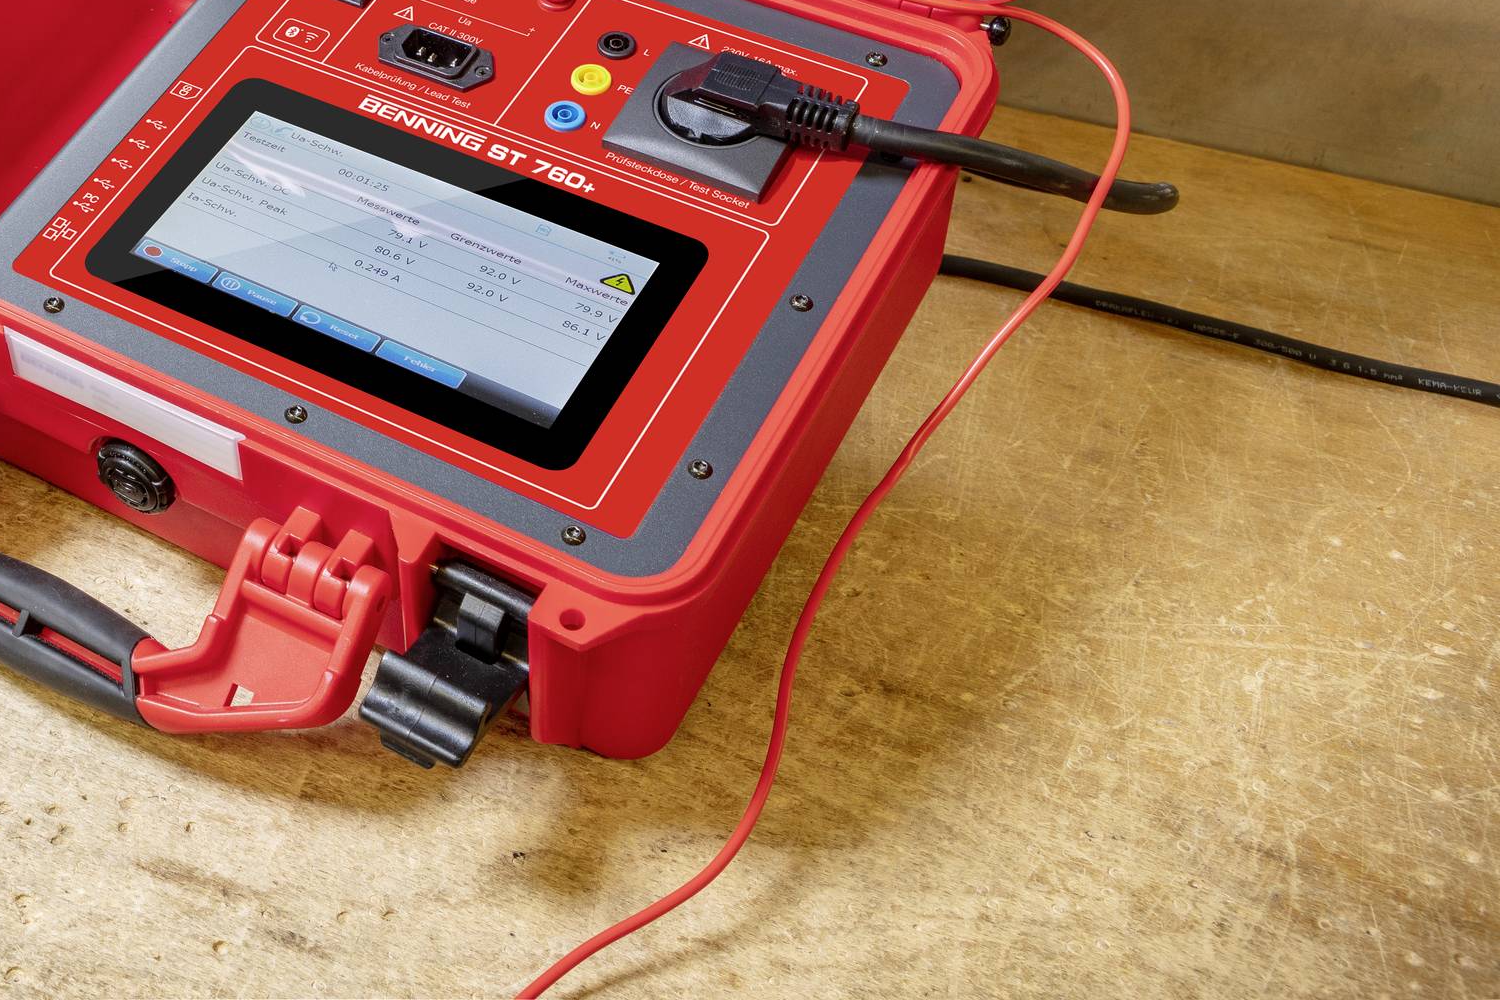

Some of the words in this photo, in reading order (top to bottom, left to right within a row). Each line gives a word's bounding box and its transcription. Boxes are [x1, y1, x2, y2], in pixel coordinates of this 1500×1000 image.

[458, 16, 472, 26] Ua
[428, 22, 448, 33] CAT
[457, 32, 483, 45] 300V
[355, 62, 417, 90] Kabelprüfung
[424, 88, 449, 101] Lead
[451, 96, 471, 109] Test
[617, 85, 634, 96] PE
[590, 121, 601, 130] N
[290, 131, 344, 158] Ua-Schw.
[358, 94, 487, 152] BENNING
[487, 145, 527, 166] ST
[531, 159, 596, 194] 760+
[241, 131, 287, 153] Testzeit
[338, 168, 390, 192] 00:01:25
[605, 151, 679, 184] Prüfsteckdose
[688, 181, 710, 195] Test
[711, 189, 750, 209] Socket
[82, 192, 100, 204] PC
[186, 191, 238, 218] Ia-Schw.
[354, 259, 389, 278] 0.249
[390, 274, 401, 284] A
[214, 161, 269, 188] Ua-Schw.
[272, 183, 290, 196] DC
[387, 229, 414, 245] 79.1
[418, 240, 428, 250] V
[479, 264, 507, 281] 92.0
[512, 276, 522, 286] V
[574, 302, 603, 318] 79.9
[608, 315, 618, 324] V
[200, 176, 255, 204] Ua-Schw.
[258, 199, 289, 217] Peak
[374, 245, 401, 261] 80.6
[405, 256, 416, 266] V
[466, 282, 494, 298] 92.0
[498, 293, 509, 303] V
[562, 320, 590, 337] 86.1
[596, 332, 606, 342] V
[356, 195, 421, 227] Messwerte
[450, 232, 523, 265] Grenzwerte
[565, 276, 629, 307] Maxwerte
[170, 256, 197, 274] Stopp
[247, 288, 277, 306] Pause
[329, 323, 360, 341] Reset
[403, 354, 437, 374] Fehler
[1418, 377, 1482, 397] KEMA-KEUR
